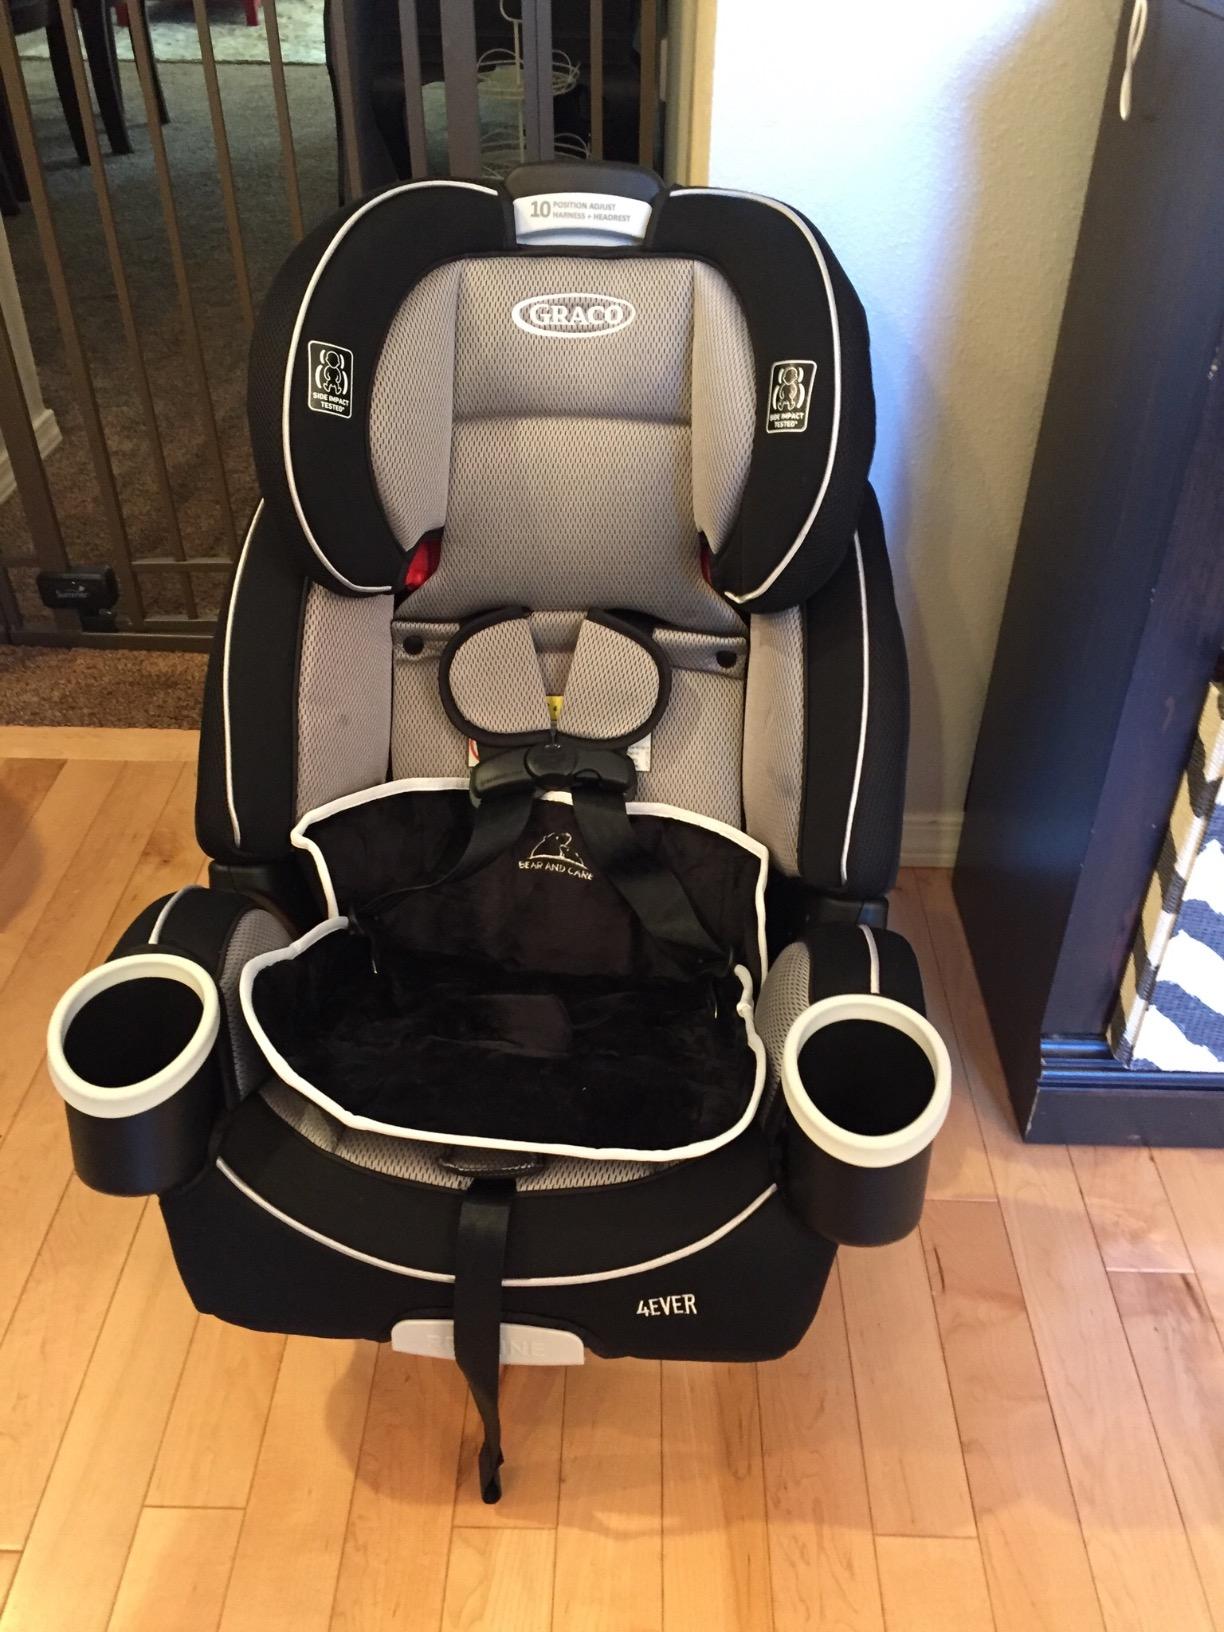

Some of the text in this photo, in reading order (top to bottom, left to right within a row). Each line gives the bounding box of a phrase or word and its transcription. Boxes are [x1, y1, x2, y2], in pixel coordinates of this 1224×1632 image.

[530, 200, 616, 218] 10 POSITION ADJUST
[552, 212, 586, 220] HARNESS
[593, 213, 631, 222] HEADREST
[529, 303, 624, 325] GRACO
[312, 392, 350, 406] SIDE IMPACT
[781, 411, 805, 420] IMPACT
[518, 861, 543, 869] BEAR
[544, 862, 566, 873] AND
[636, 1293, 698, 1317] 4EVER
